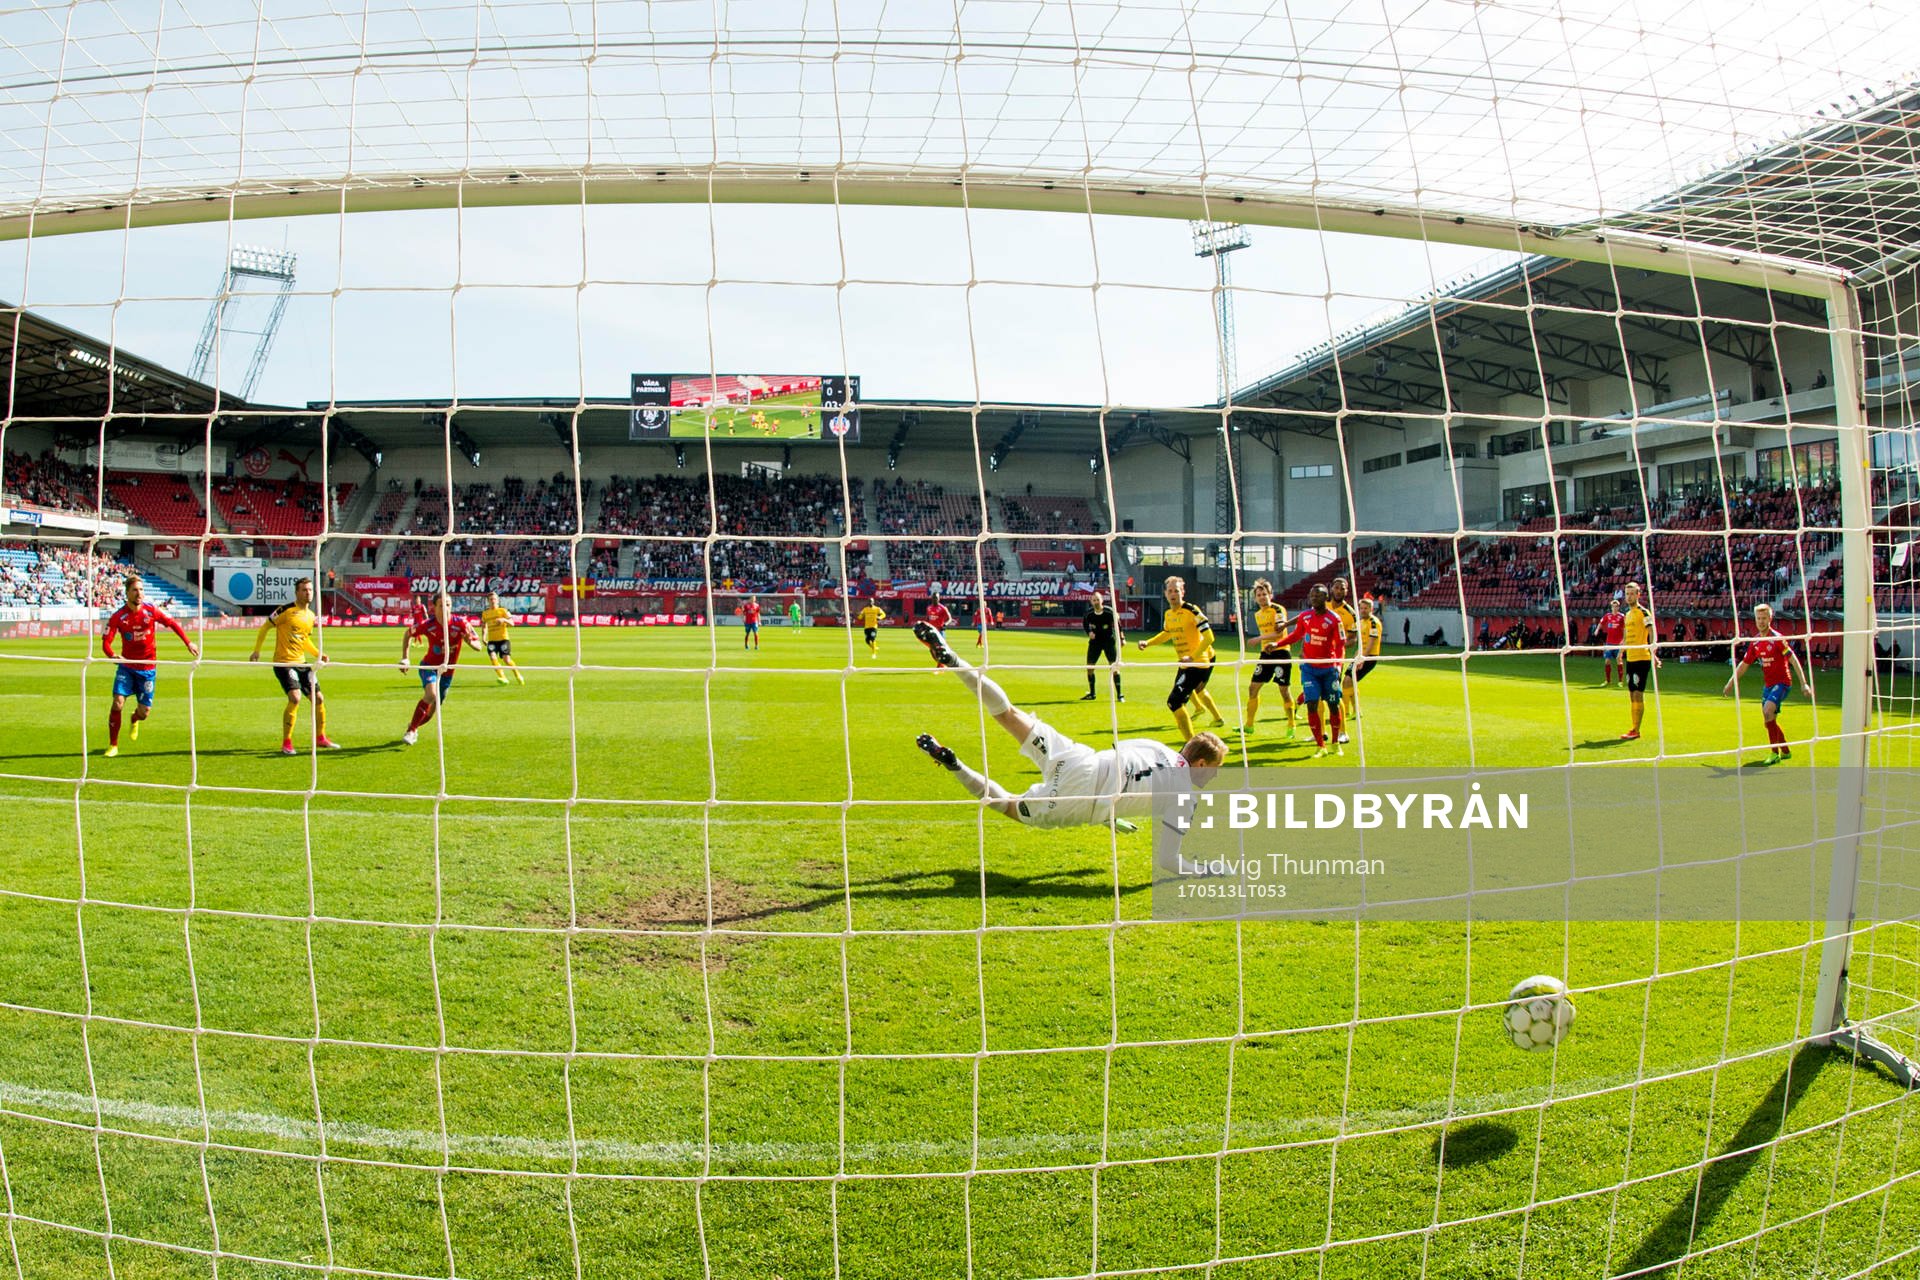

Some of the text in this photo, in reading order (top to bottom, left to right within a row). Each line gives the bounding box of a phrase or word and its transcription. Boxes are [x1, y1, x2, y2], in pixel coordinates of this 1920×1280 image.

[826, 387, 833, 396] 0
[256, 573, 298, 587] Resurs
[596, 579, 703, 591] SKÅNES STOLTHET
[256, 587, 288, 601] Bank
[945, 581, 1060, 596] KALLE SVENSSON
